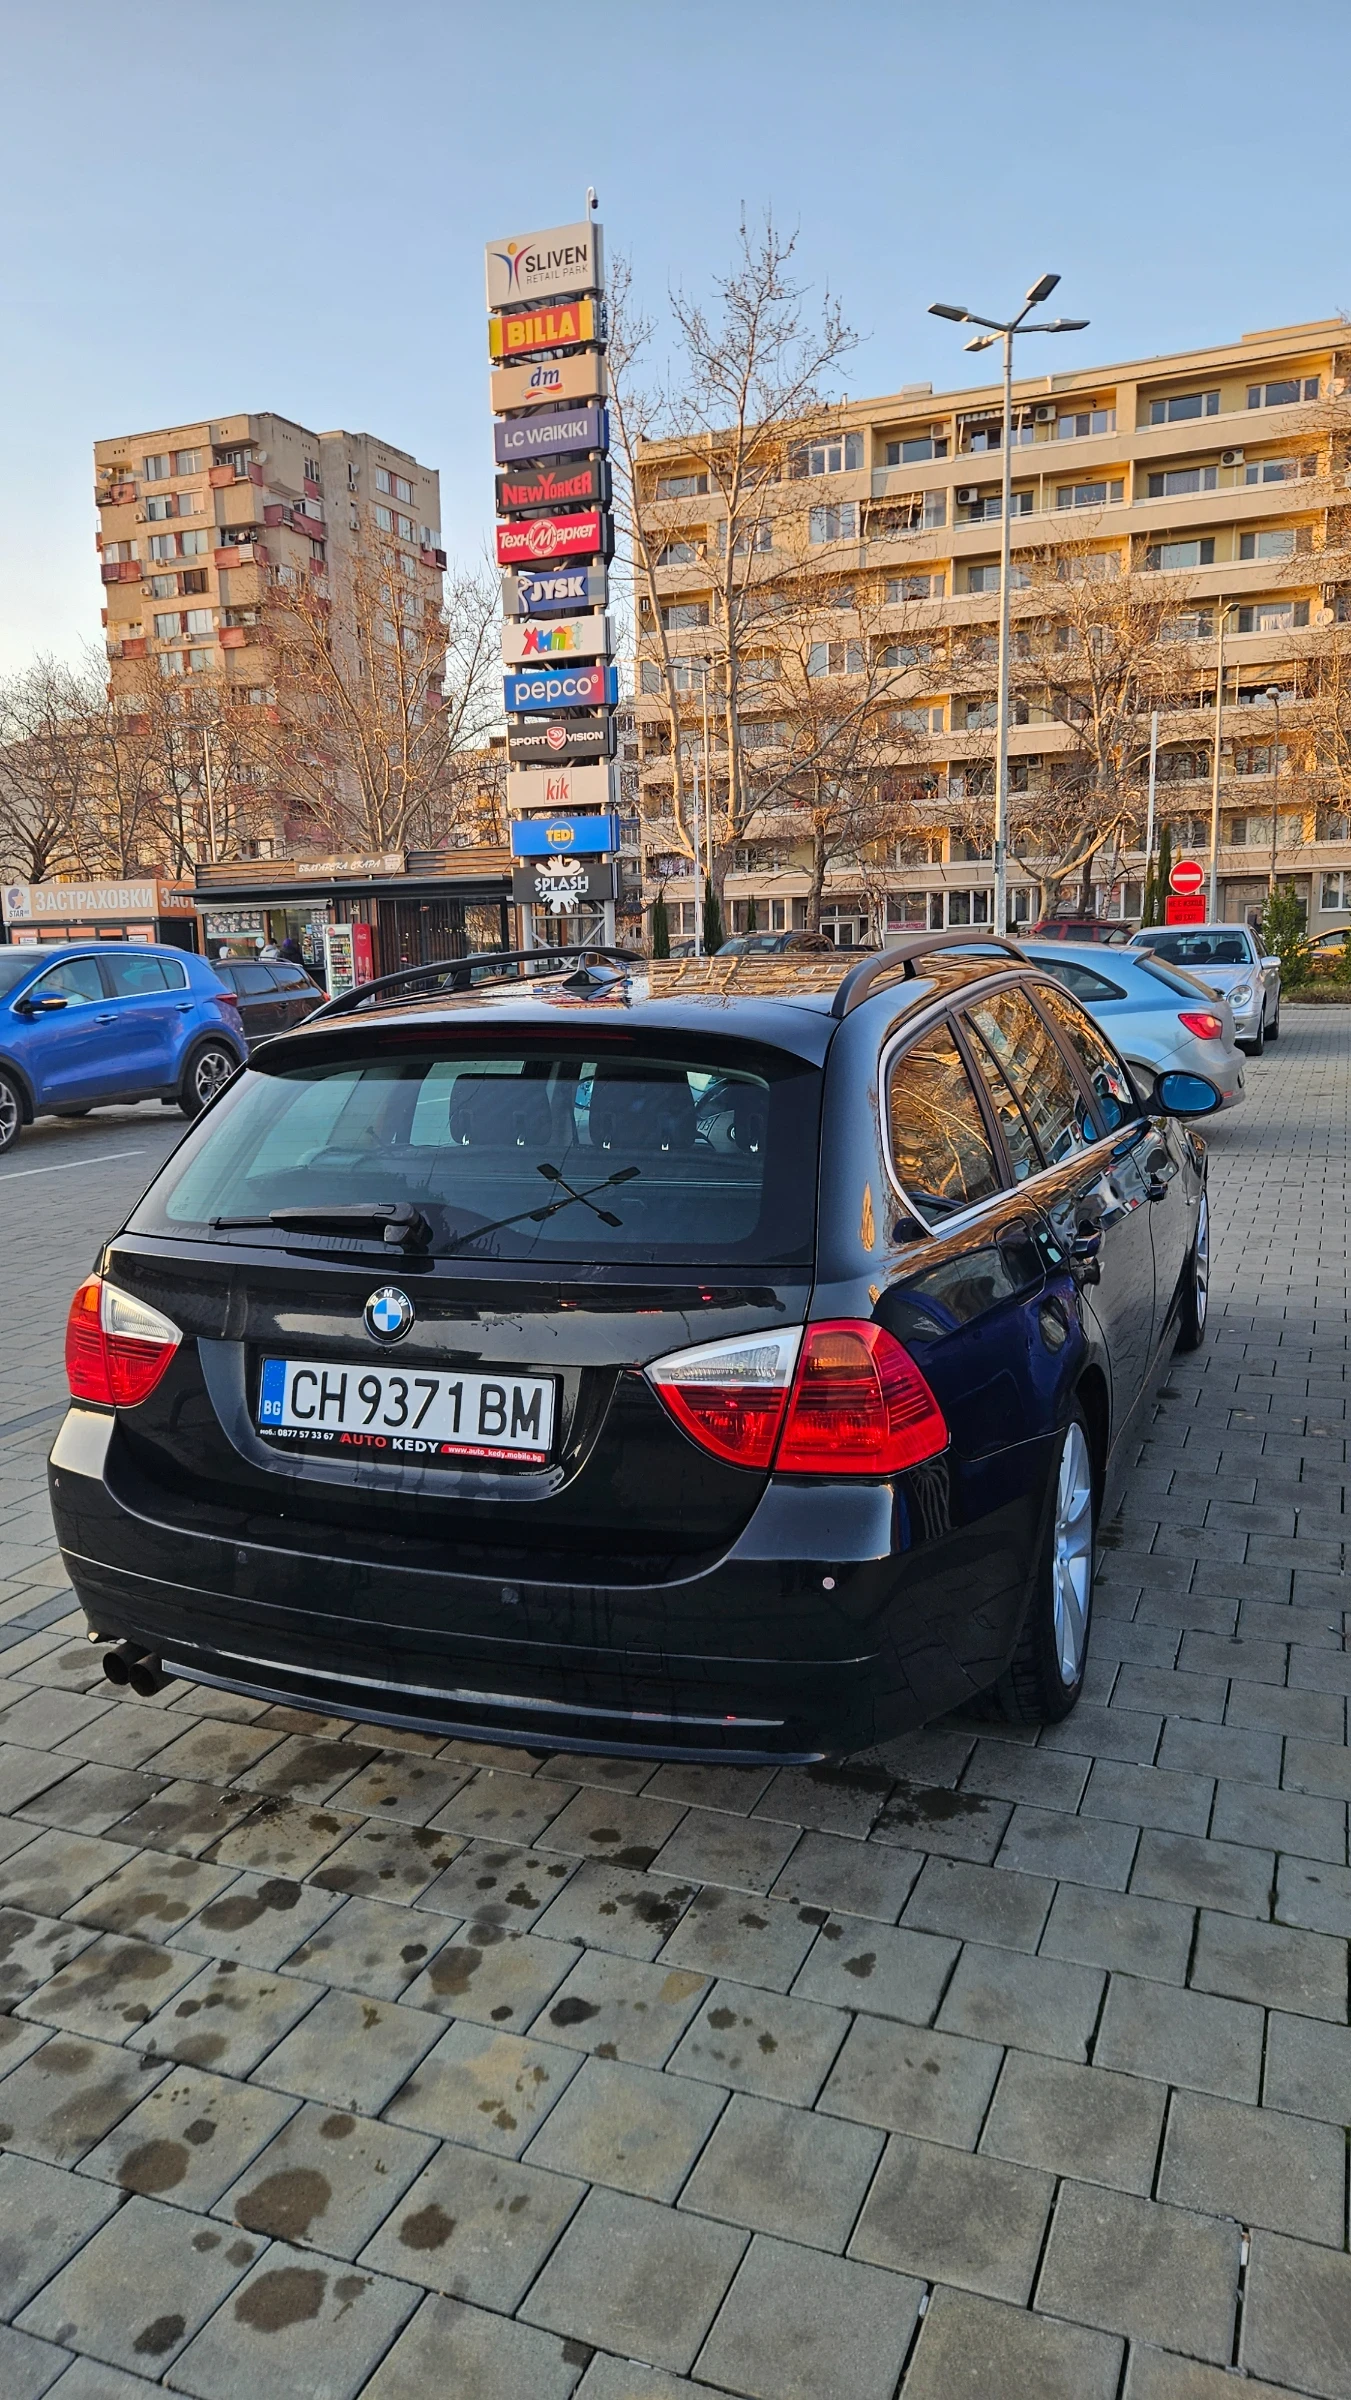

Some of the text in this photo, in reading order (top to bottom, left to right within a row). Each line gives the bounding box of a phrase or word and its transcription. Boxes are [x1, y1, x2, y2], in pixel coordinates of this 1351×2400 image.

[525, 244, 588, 273] SLIVEN
[526, 264, 589, 285] RETAIL PARK
[507, 310, 576, 348] BILLA
[530, 366, 560, 388] dm
[504, 431, 525, 448] LC
[530, 576, 586, 603] JYSK
[509, 731, 604, 747] SPORT VISION
[350, 859, 381, 870] СКАРА
[534, 875, 589, 892] SPLASH
[35, 888, 154, 912] ЗАСТРАХОВКИ
[369, 1288, 409, 1307] BMW
[263, 1400, 281, 1416] BG
[291, 1369, 543, 1440] CH 9371 BM
[277, 1429, 297, 1438] 0877
[299, 1430, 309, 1439] 57
[311, 1431, 322, 1439] 33
[323, 1432, 334, 1440] 67
[340, 1432, 440, 1453] AUTO KEDY
[448, 1446, 542, 1462] www.auto_kedy.mobile.bg
